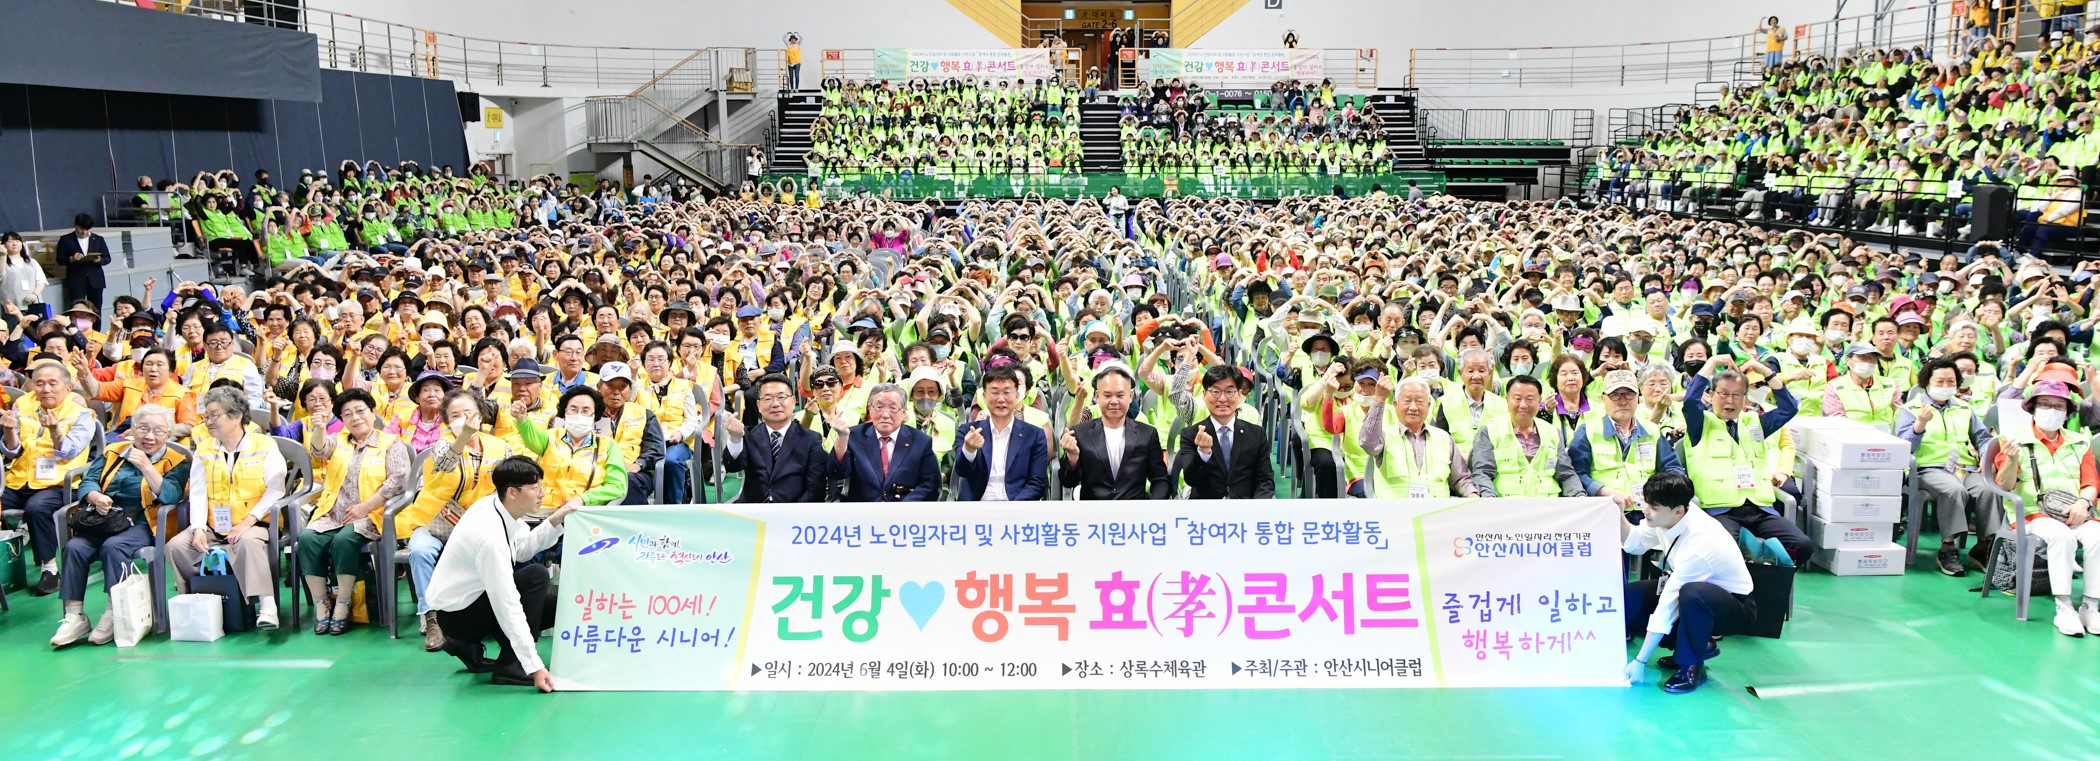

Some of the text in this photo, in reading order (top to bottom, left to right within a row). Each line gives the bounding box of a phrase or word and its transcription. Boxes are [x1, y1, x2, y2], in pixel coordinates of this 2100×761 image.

[1102, 20, 1118, 29] 2-6
[910, 61, 929, 73] 건강
[940, 61, 960, 73] 행복
[1184, 61, 1204, 73] 건강
[1214, 61, 1234, 73] 행복
[792, 517, 1388, 549] 2024년 노인일자리 및 사회활동 지원사업 「참여자 통합 문화활동」
[1505, 533, 1551, 541] 노인일자리
[1554, 533, 1590, 541] 전담기관
[628, 534, 657, 551] 시민과
[1475, 542, 1592, 557] 안산시니어클럽
[636, 551, 732, 566] 자유로운 혁신도시 안산
[575, 589, 717, 621] 일하는 100세!
[771, 570, 1419, 642] 건강 행복 효(孝)콘서트
[1442, 590, 1617, 624] 즐겁게 일하고
[560, 625, 736, 654] 아름다운 시니어!
[1462, 629, 1596, 661] 행복하게^^
[765, 661, 792, 678] 일시
[808, 661, 853, 678] 2024년
[860, 661, 881, 679] 6월
[887, 661, 934, 679] 4일(화)
[943, 663, 979, 677] 10:00
[1001, 663, 1037, 677] 12:00
[1075, 660, 1103, 678] 장소
[1120, 660, 1206, 678] 상록수체육관
[1245, 659, 1308, 678] 주최/주관
[1324, 658, 1422, 677] 안산시니어클럽
